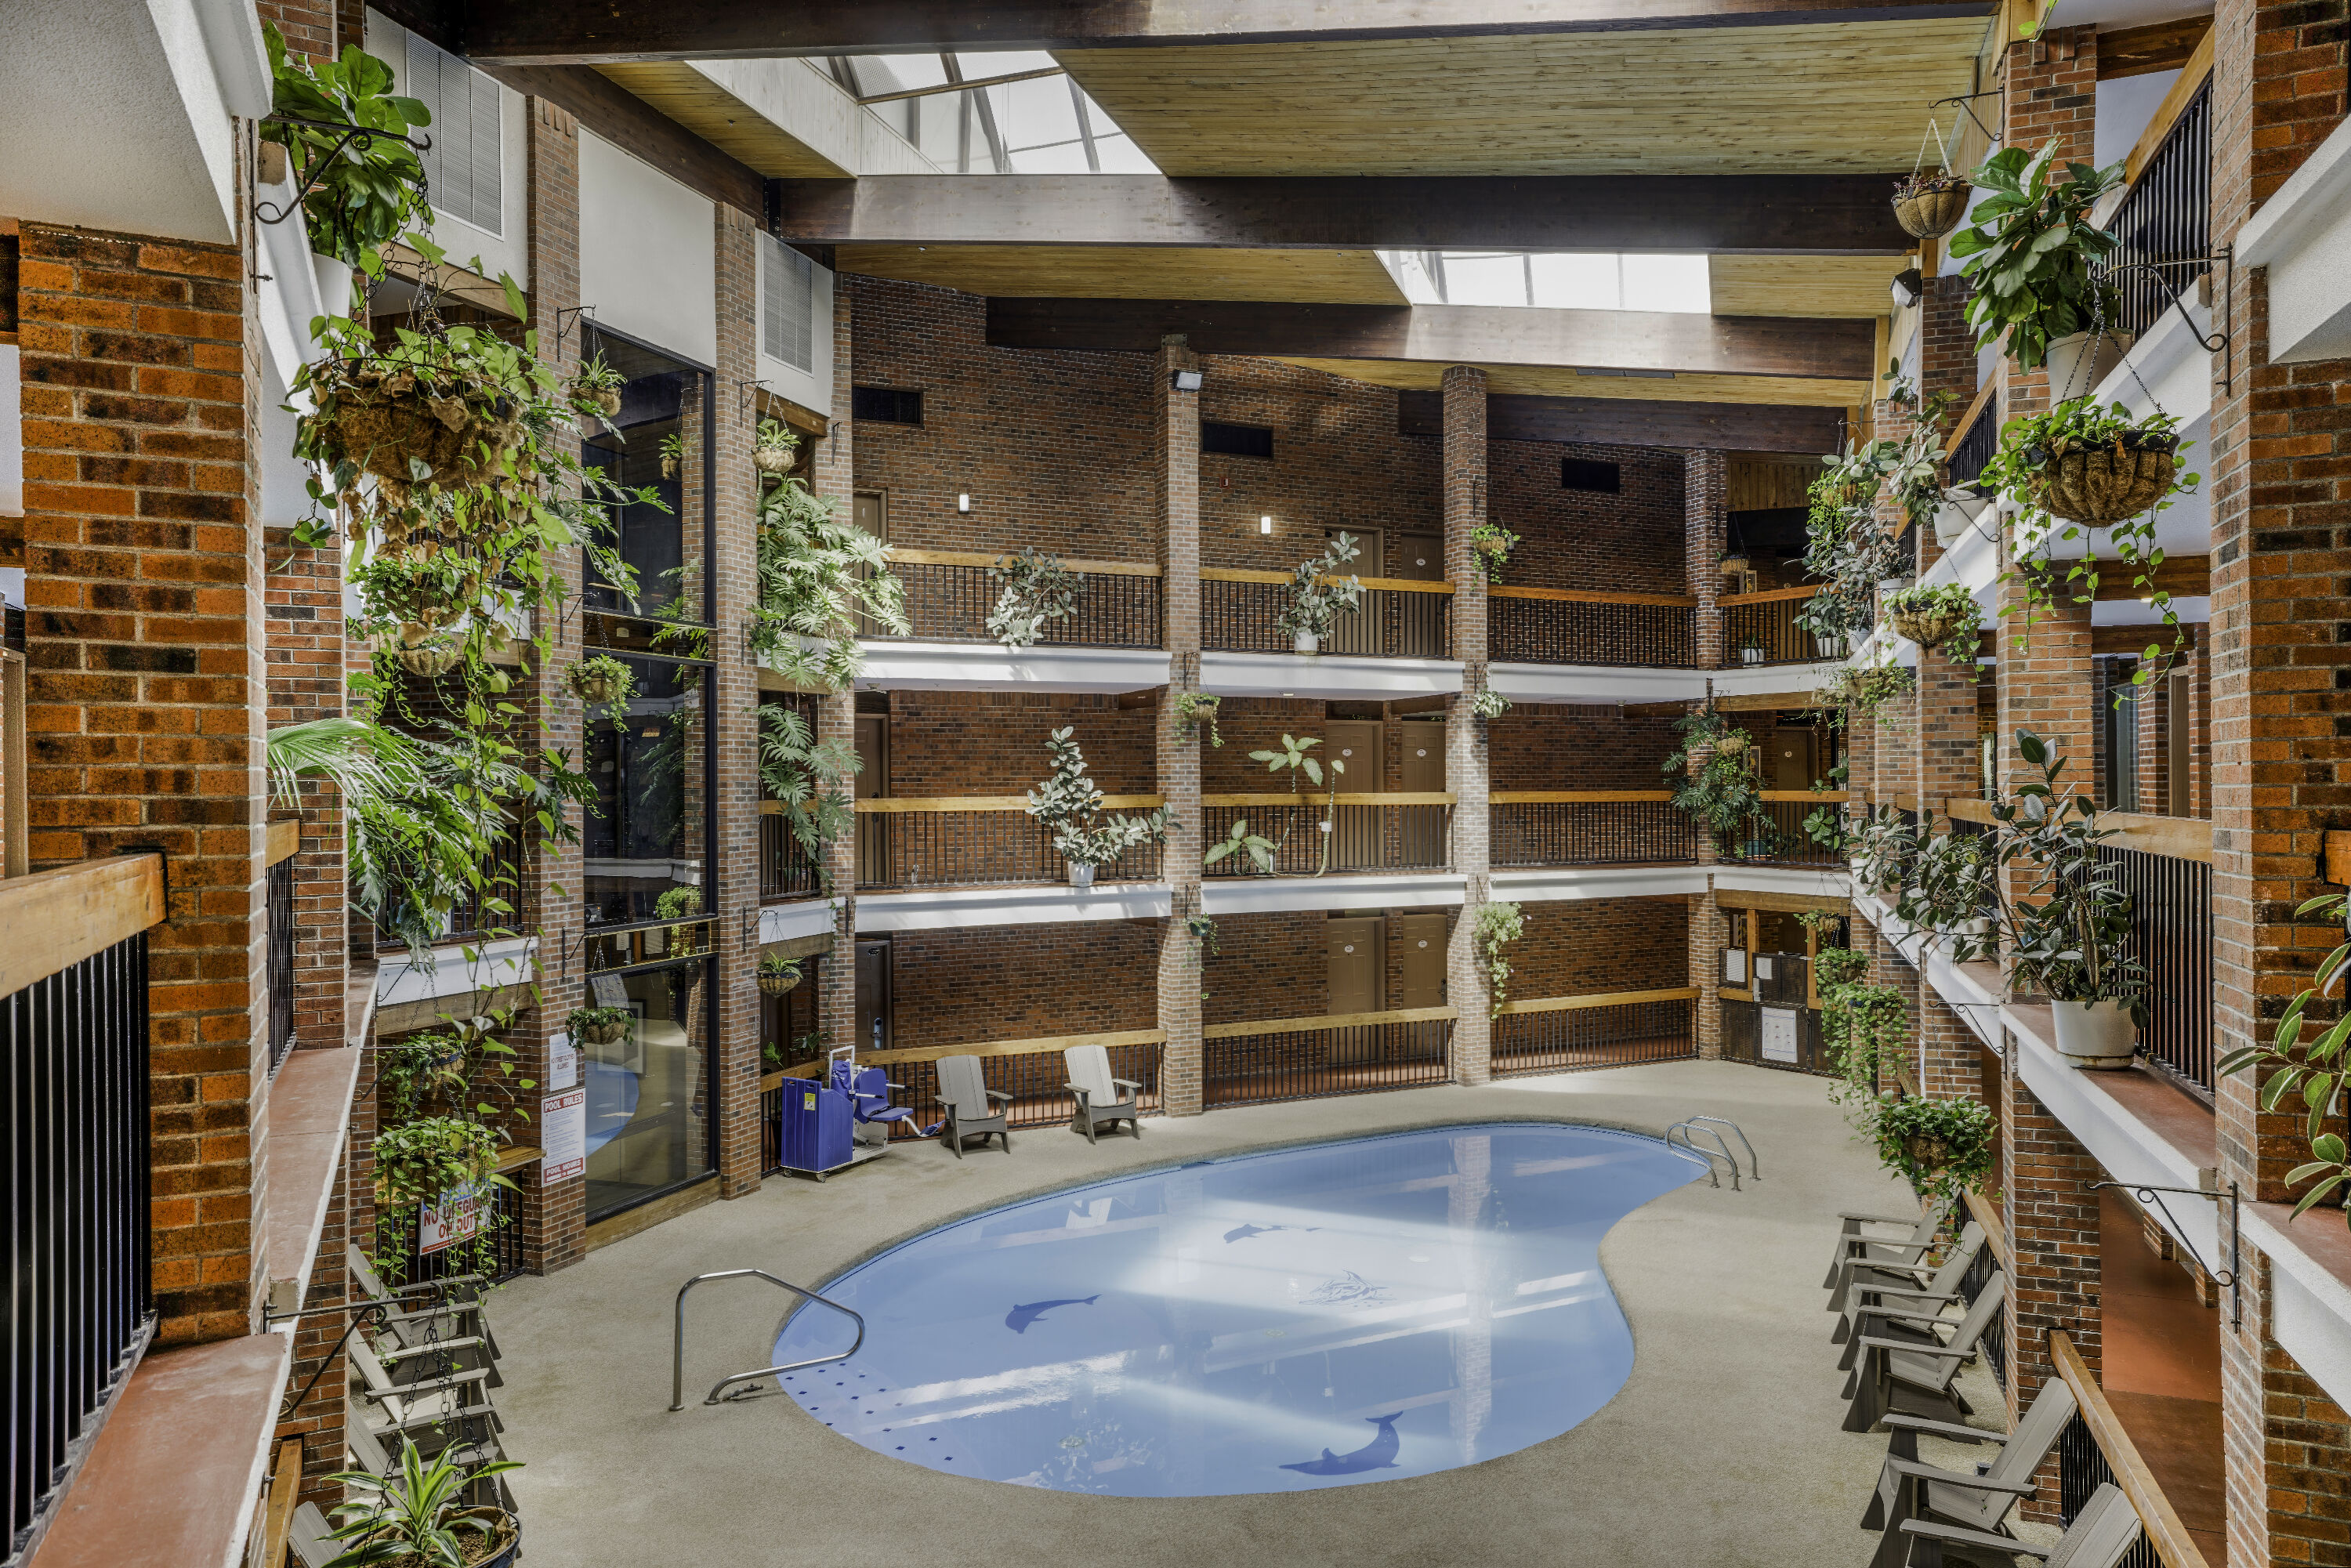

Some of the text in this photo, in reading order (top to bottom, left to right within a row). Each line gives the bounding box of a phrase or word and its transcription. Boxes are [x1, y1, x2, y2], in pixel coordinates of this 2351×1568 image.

[545, 1094, 583, 1112] POOL RULES
[546, 1166, 561, 1176] POOL
[563, 1159, 581, 1171] HOURS
[424, 1210, 439, 1227] NO
